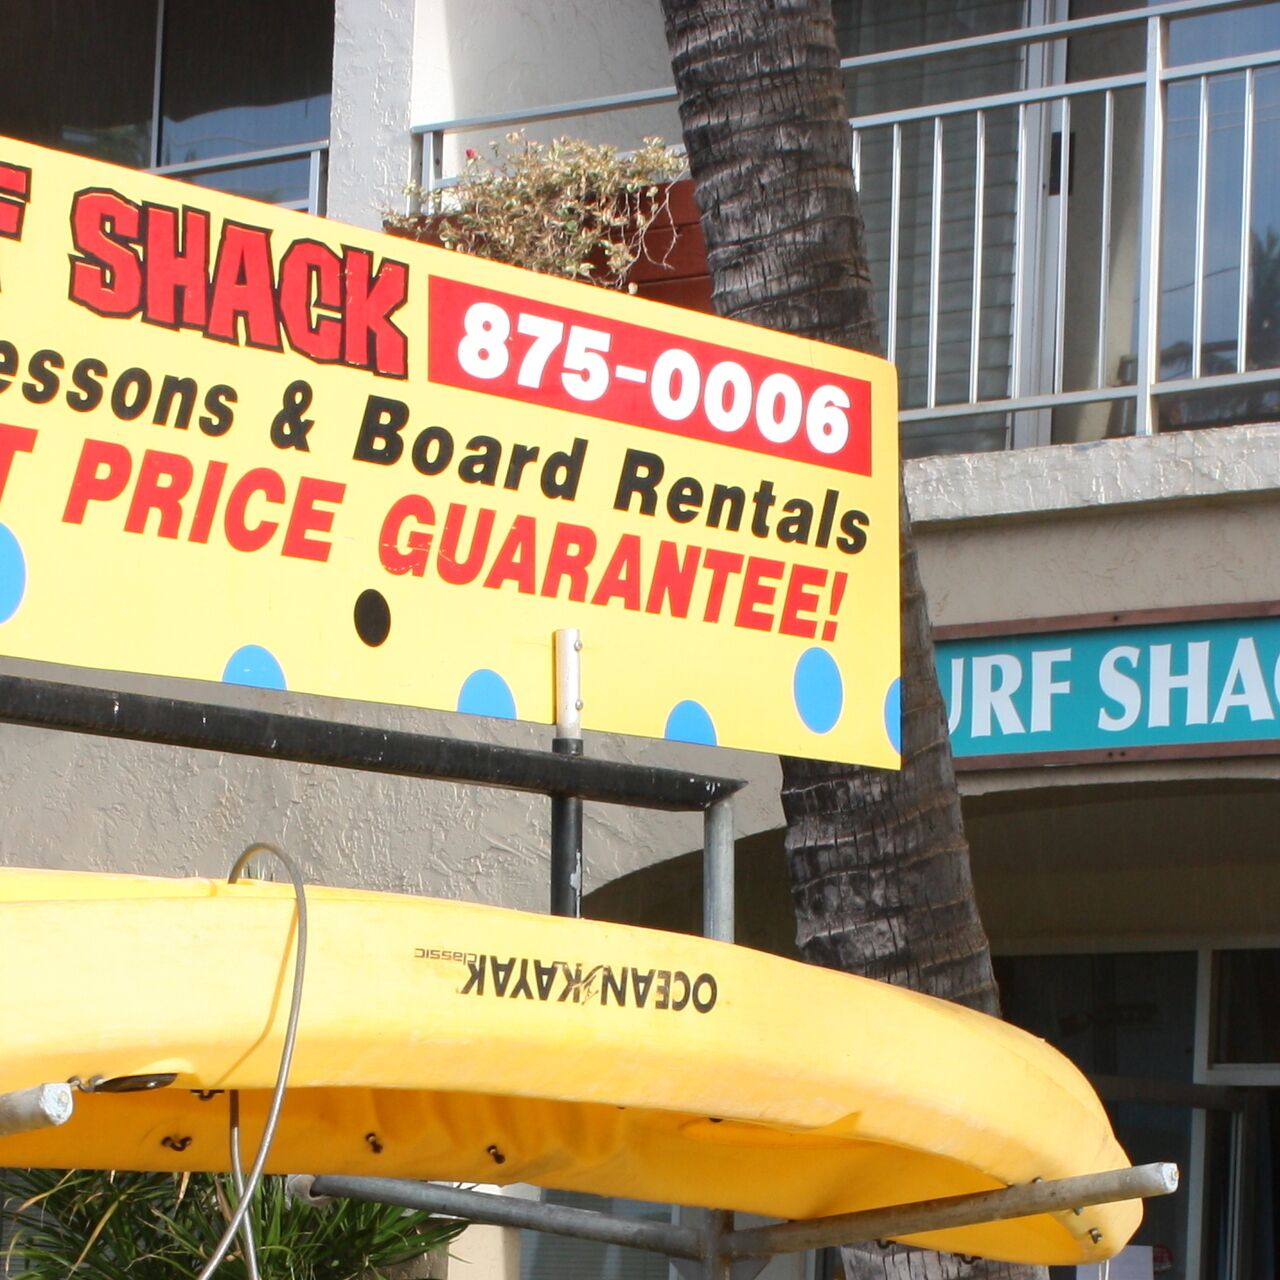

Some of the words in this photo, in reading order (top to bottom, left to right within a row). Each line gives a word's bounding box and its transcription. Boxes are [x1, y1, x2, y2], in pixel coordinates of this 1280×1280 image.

[67, 186, 410, 379] SHACK
[457, 301, 851, 455] 875-0006
[270, 379, 314, 452] &
[353, 395, 588, 500] Board
[614, 449, 870, 554] Rentals
[62, 438, 345, 562] PRICE
[378, 492, 848, 642] GUARANTEE!
[948, 648, 1072, 737] RF
[415, 948, 477, 965] classic
[460, 955, 583, 1003] KAYAK
[601, 966, 718, 1014] OCEAN
